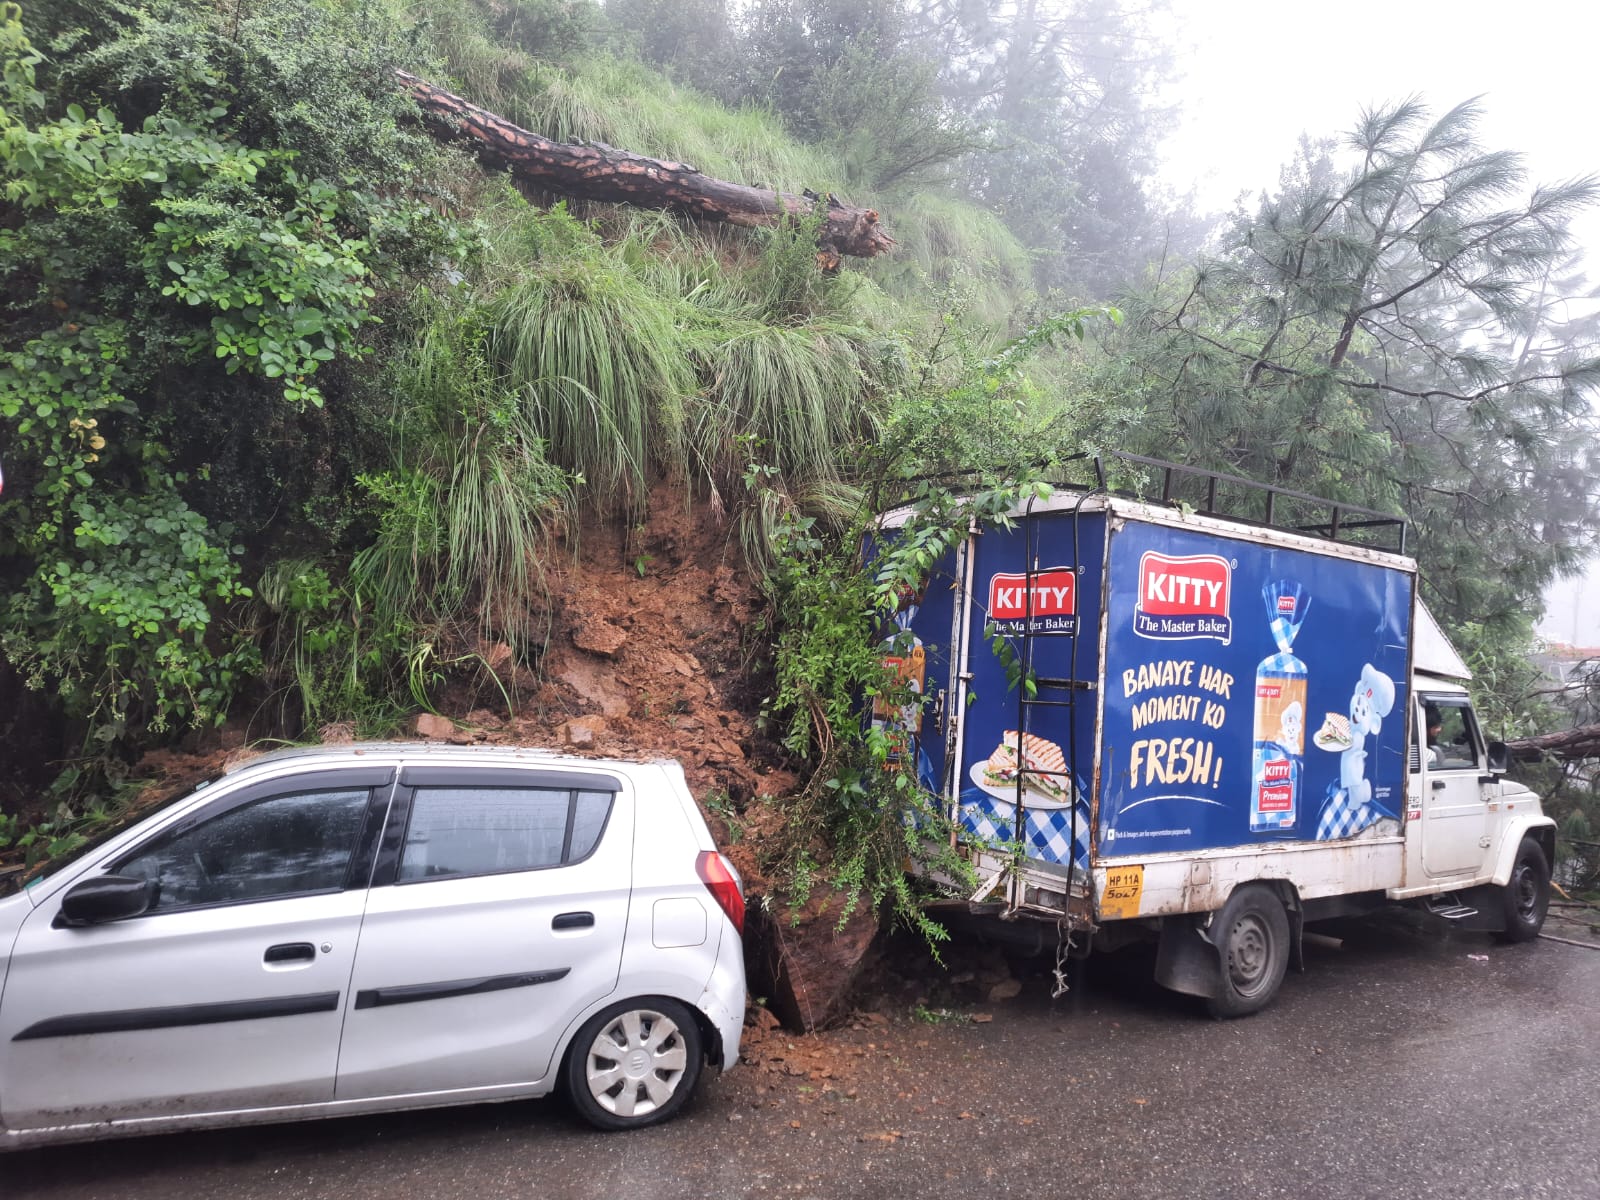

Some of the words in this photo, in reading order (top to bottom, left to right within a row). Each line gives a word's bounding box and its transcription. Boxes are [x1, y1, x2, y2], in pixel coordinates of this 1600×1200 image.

[996, 586, 1070, 609] KITTY
[1146, 571, 1223, 608] KITTY
[1009, 620, 1042, 631] Mater
[1045, 616, 1075, 629] Baker
[1139, 615, 1159, 632] The
[1161, 618, 1195, 633] Master
[1198, 618, 1227, 633] Baker
[1122, 660, 1195, 698] BANAYE
[1198, 664, 1234, 700] HAR
[1131, 695, 1201, 731] MOMENT
[1202, 700, 1226, 730] KO
[1265, 765, 1289, 777] KITTY
[1109, 875, 1121, 886] HP
